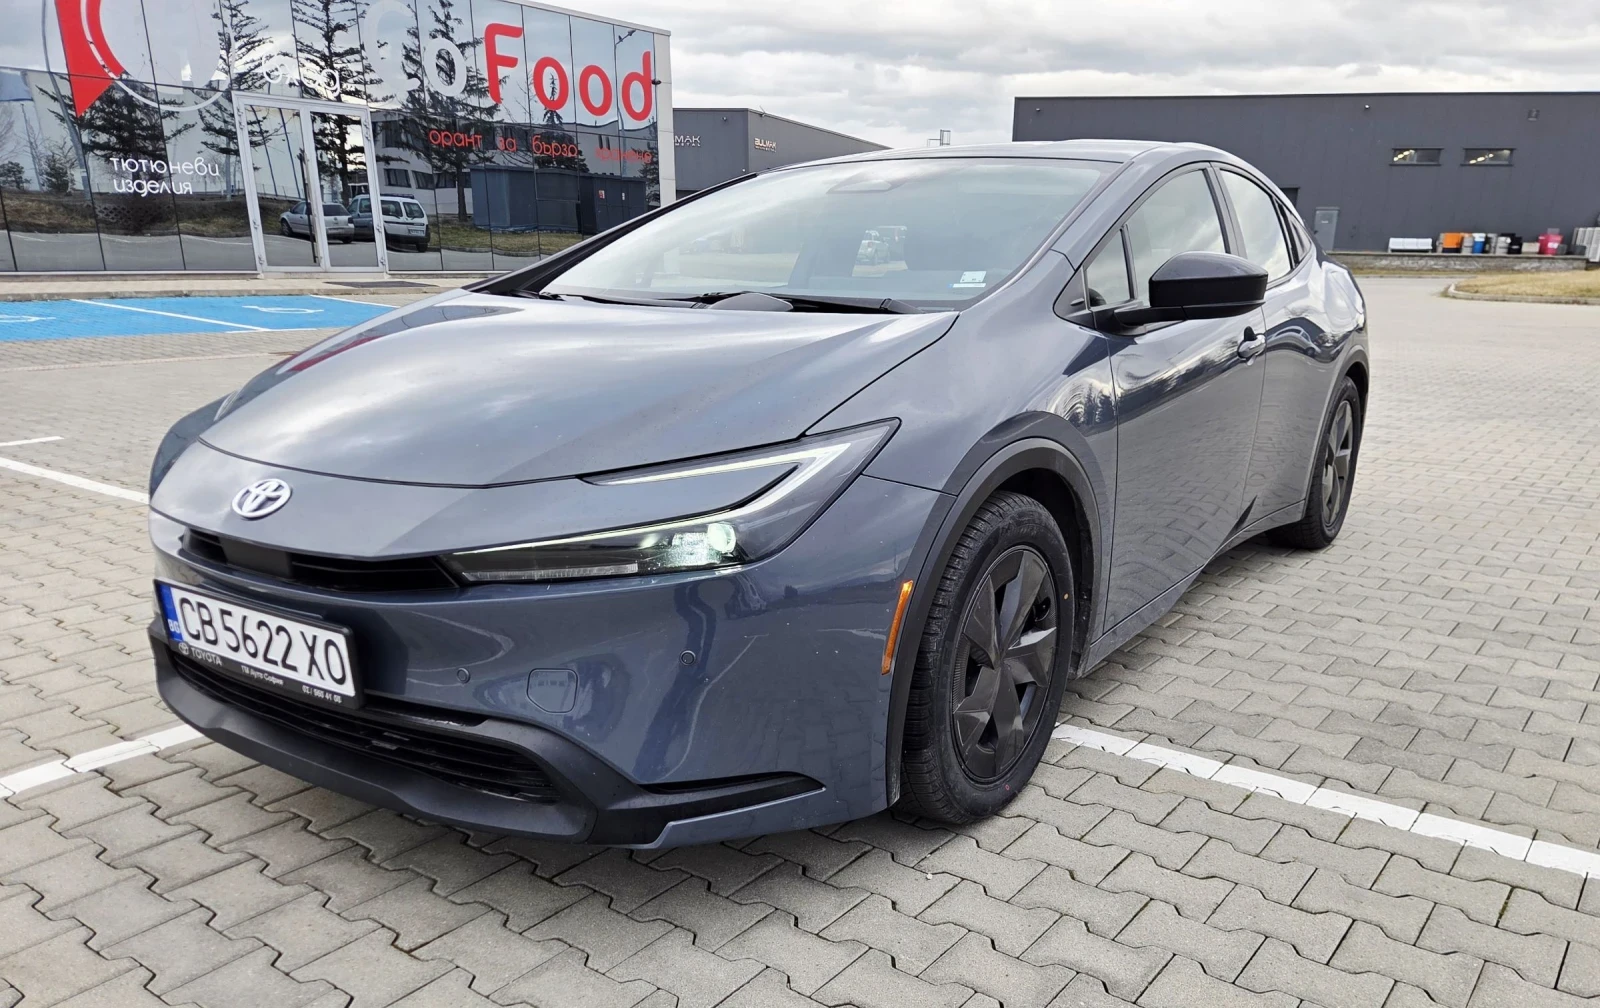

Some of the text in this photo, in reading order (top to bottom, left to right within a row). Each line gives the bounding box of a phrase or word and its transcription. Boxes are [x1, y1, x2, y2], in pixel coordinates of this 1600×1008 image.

[484, 22, 653, 122] Food
[532, 135, 578, 158] бързо
[109, 157, 220, 176] тютюневи
[113, 178, 193, 197] изделия
[167, 618, 181, 634] BG
[190, 647, 223, 666] TOYOTA
